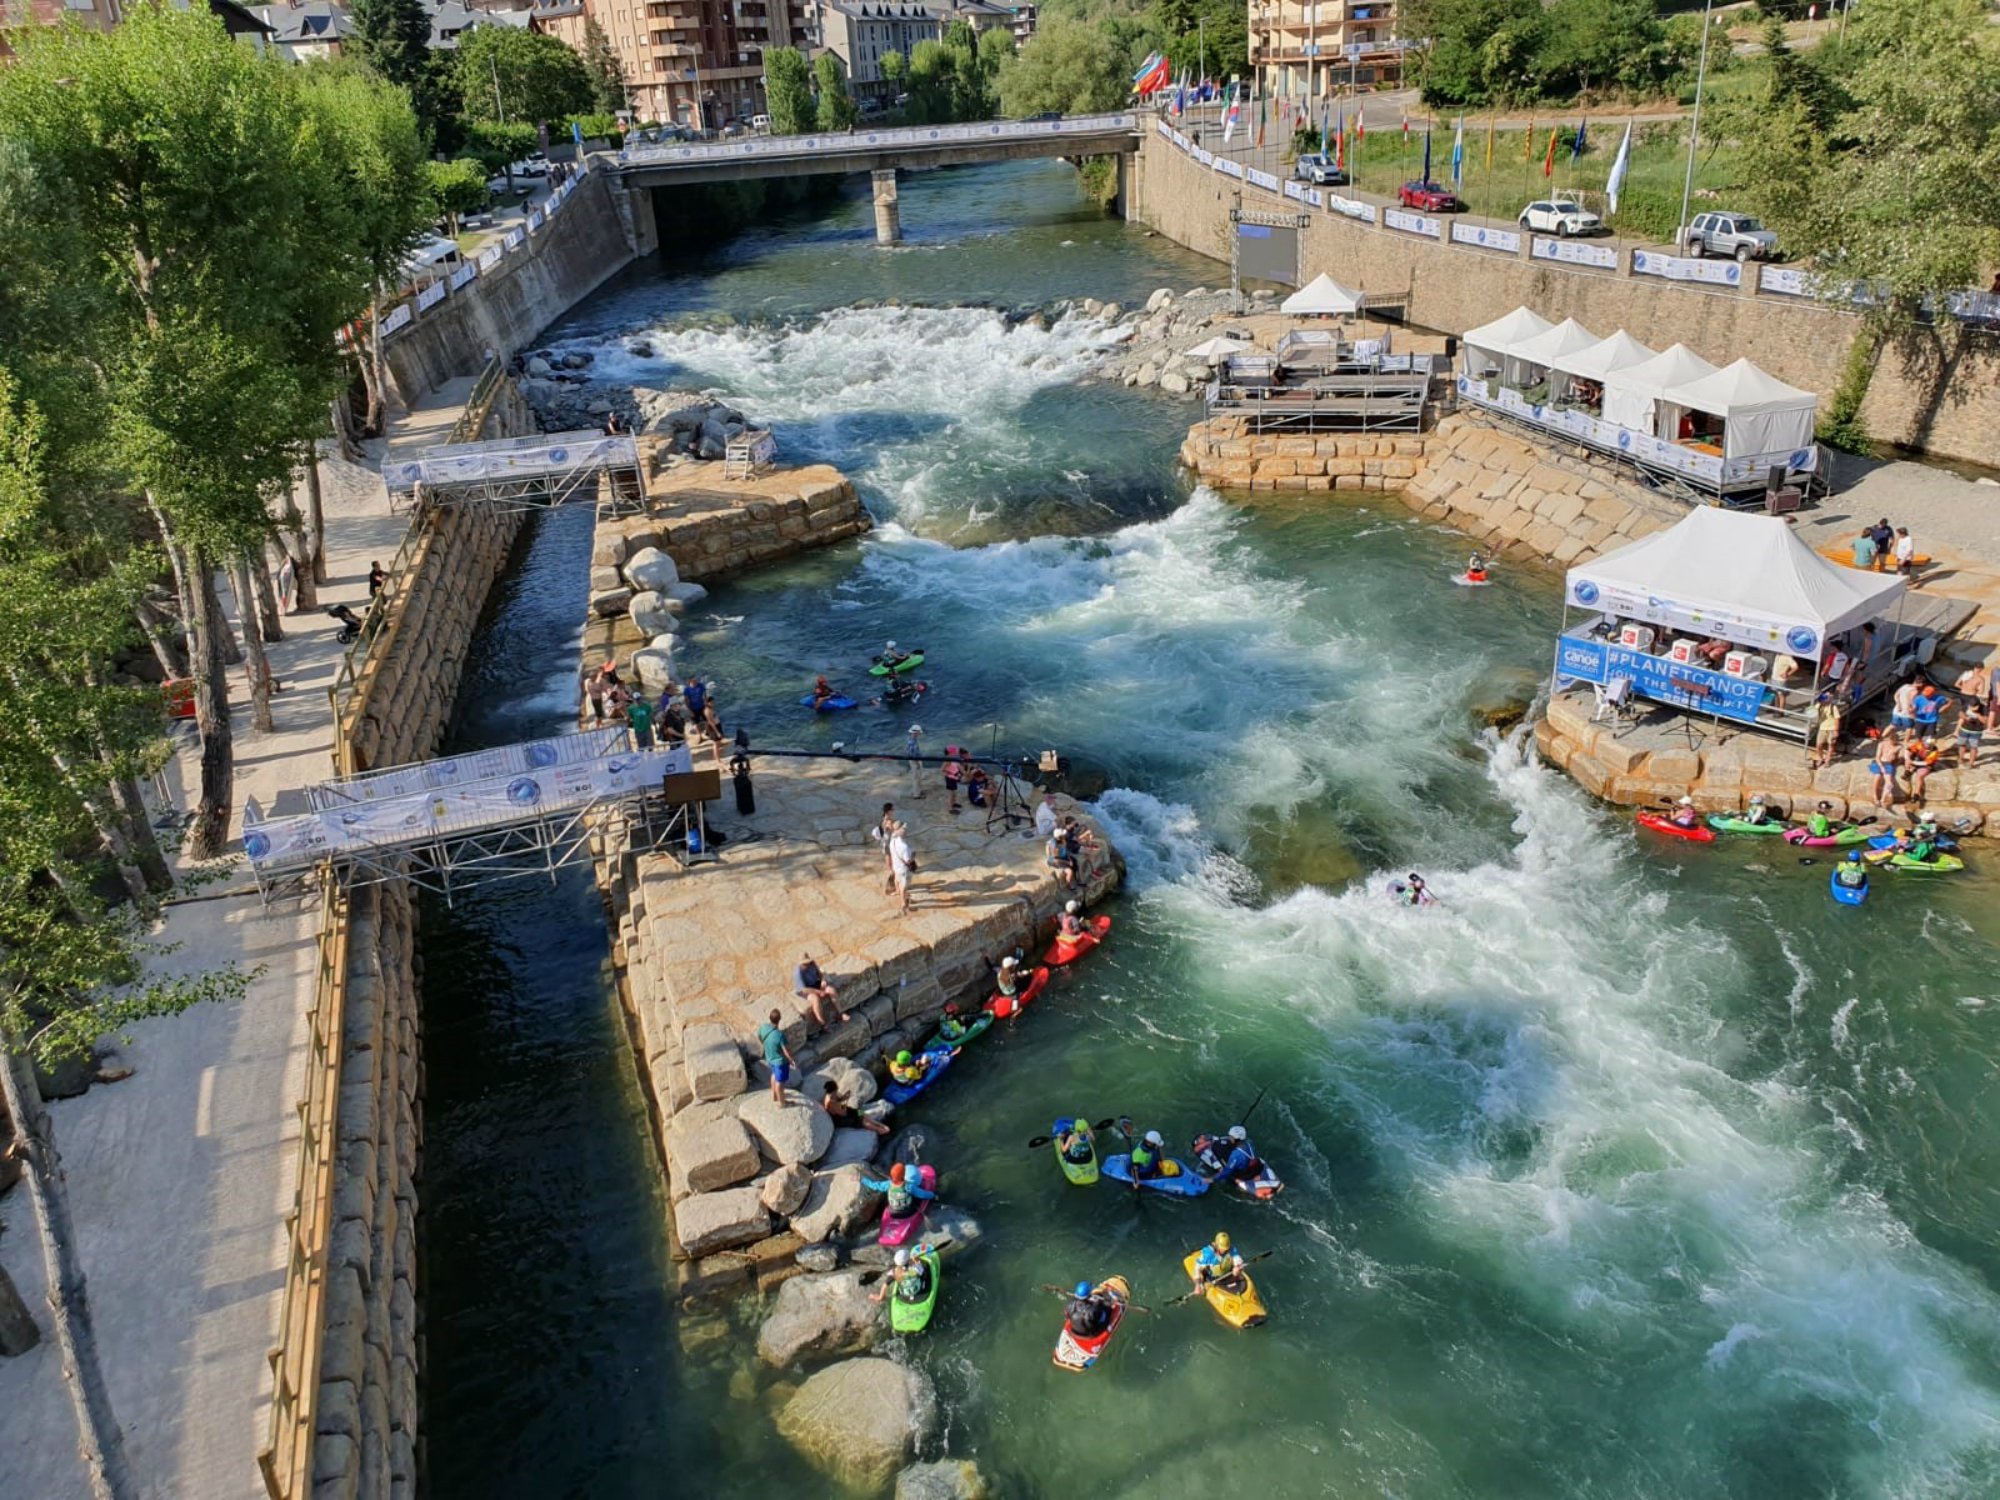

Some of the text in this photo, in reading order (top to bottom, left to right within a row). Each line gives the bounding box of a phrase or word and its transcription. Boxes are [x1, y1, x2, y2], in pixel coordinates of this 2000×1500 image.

[1564, 651, 1599, 667] canoe
[1609, 652, 1759, 698] #PLANETCANOE
[1609, 669, 1753, 712] JOIN THE COUNITY
